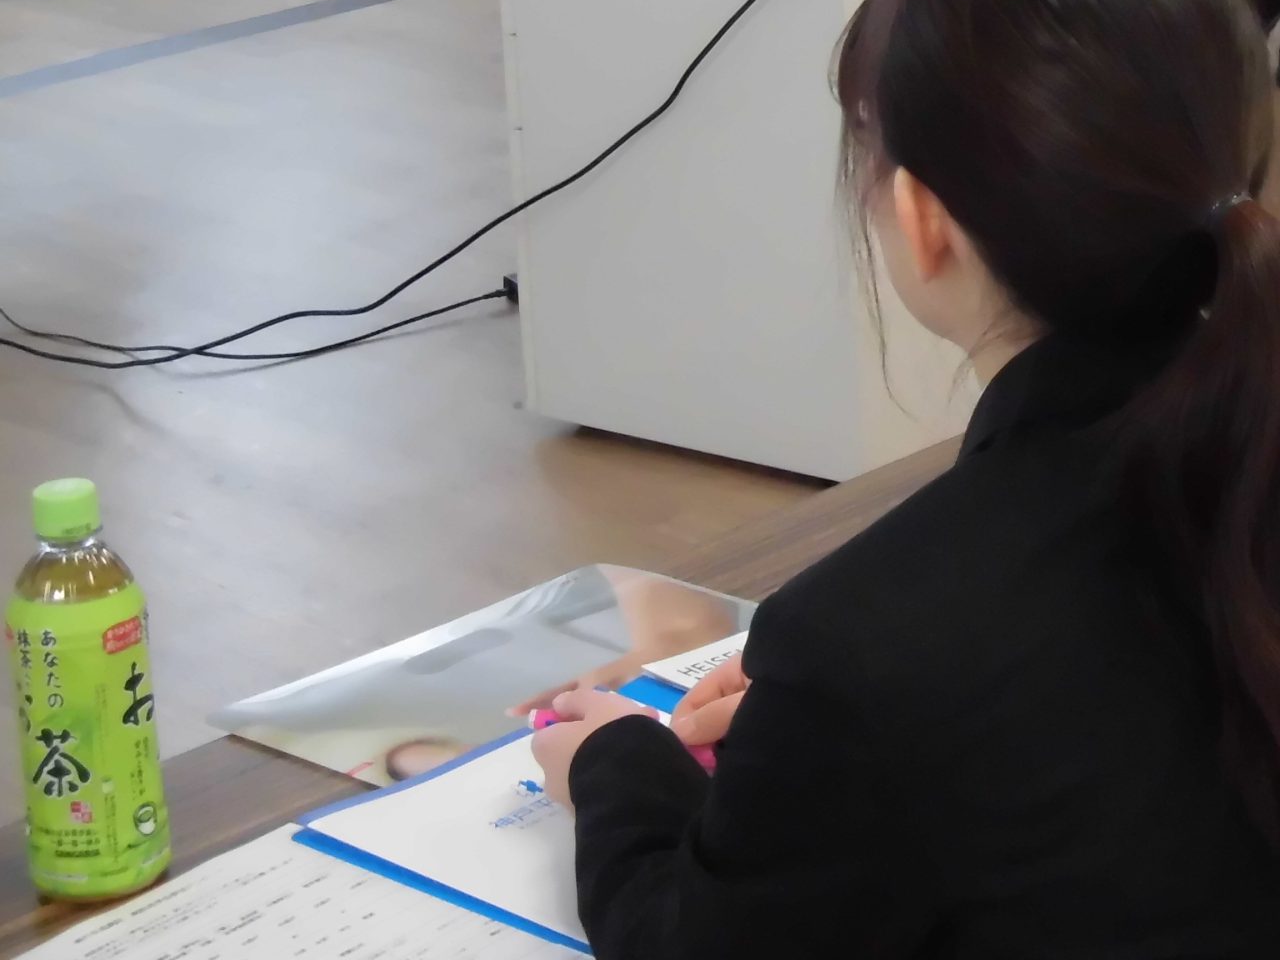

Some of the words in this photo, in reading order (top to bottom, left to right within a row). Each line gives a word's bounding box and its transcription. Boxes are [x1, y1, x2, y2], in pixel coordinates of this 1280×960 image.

[41, 629, 64, 708] あなたの
[33, 728, 91, 797] 茶
